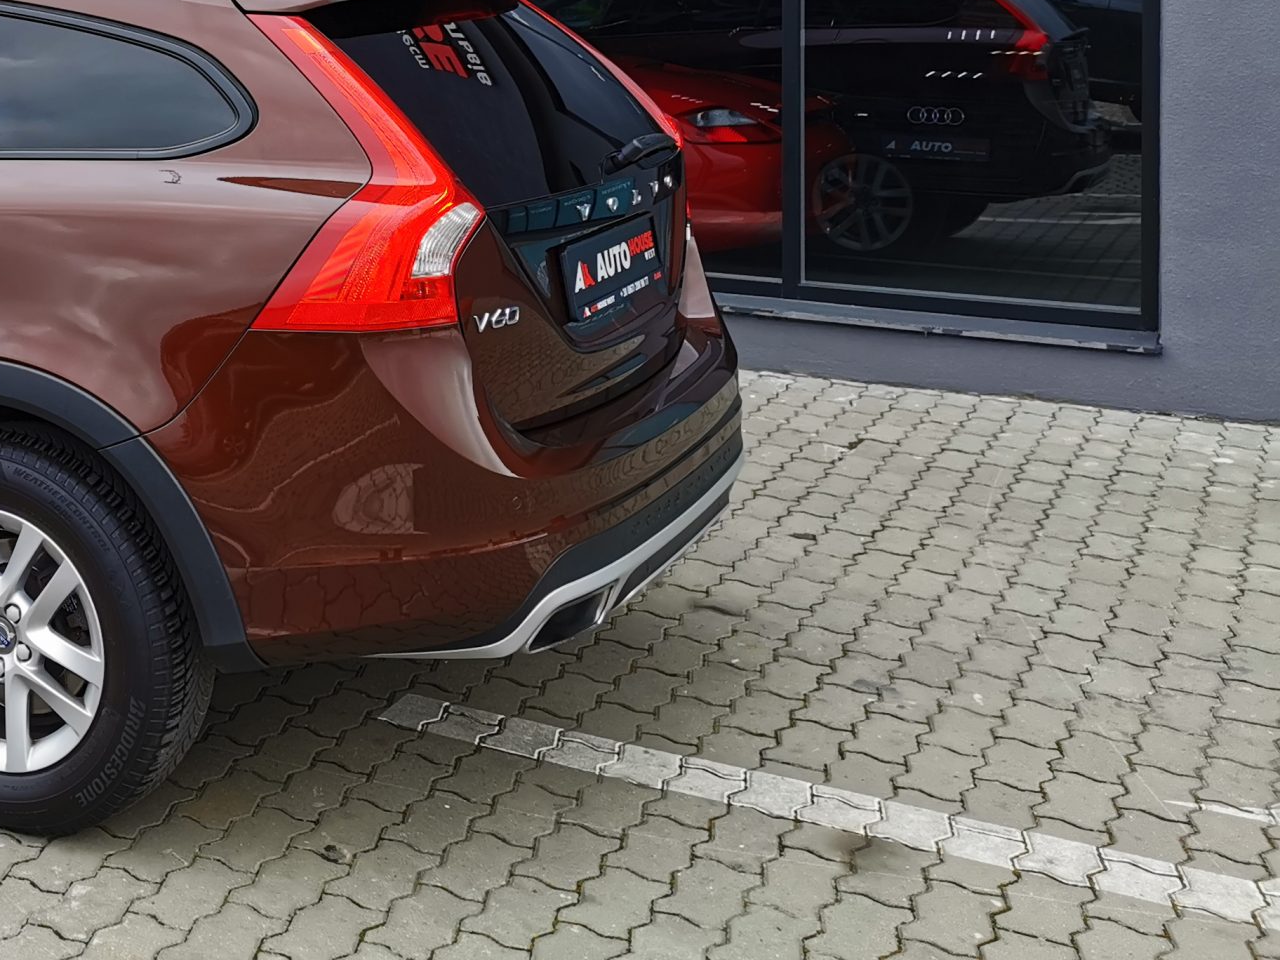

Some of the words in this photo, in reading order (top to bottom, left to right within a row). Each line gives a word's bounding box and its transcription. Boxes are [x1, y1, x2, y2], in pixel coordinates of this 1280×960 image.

[596, 241, 631, 282] AUTO
[627, 230, 655, 256] HOUSE
[473, 306, 520, 333] V60
[74, 693, 147, 808] BRIDGESTONE
